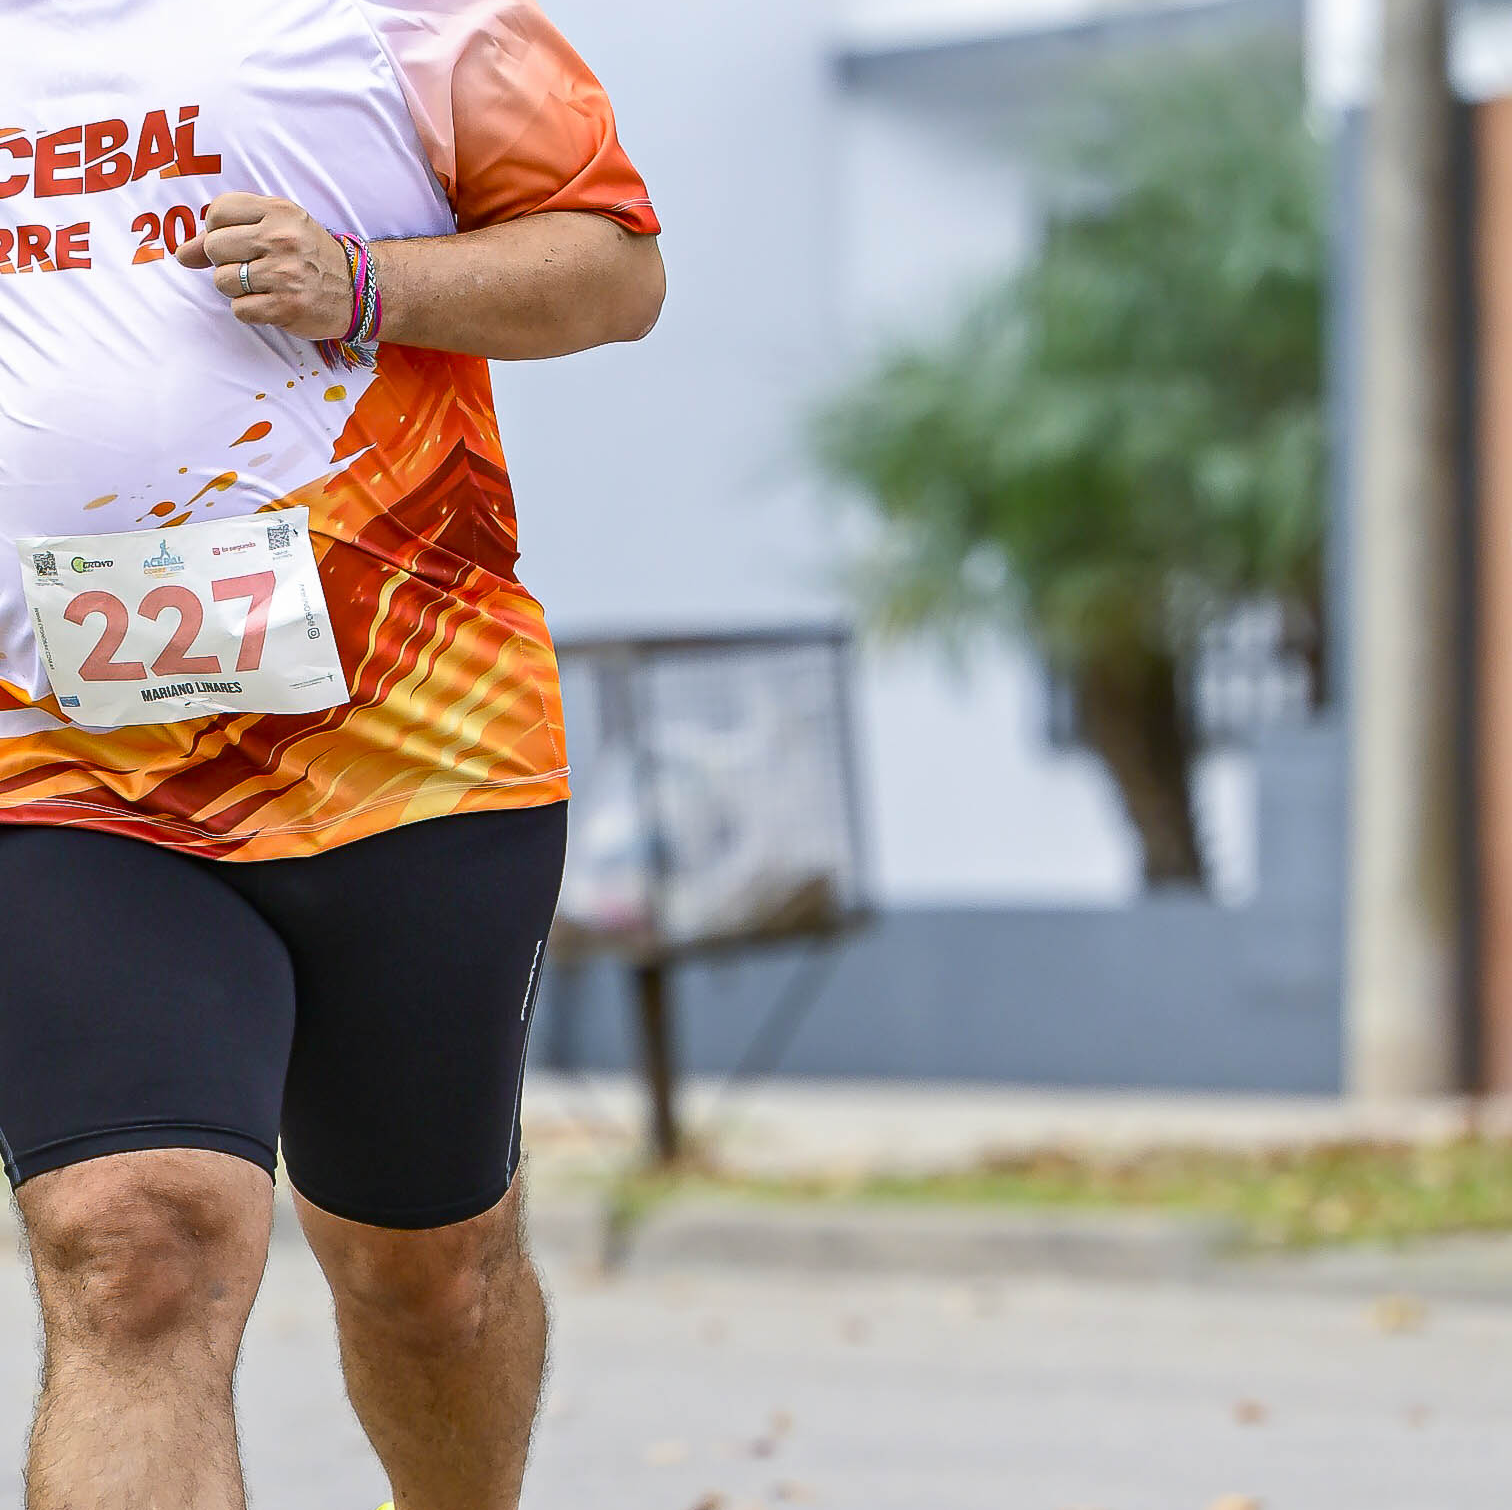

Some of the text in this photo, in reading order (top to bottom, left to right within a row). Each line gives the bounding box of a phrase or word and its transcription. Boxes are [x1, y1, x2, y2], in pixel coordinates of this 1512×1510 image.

[131, 203, 211, 266] 20
[63, 570, 277, 682] 227
[140, 681, 243, 702] MARIANO LINARES
